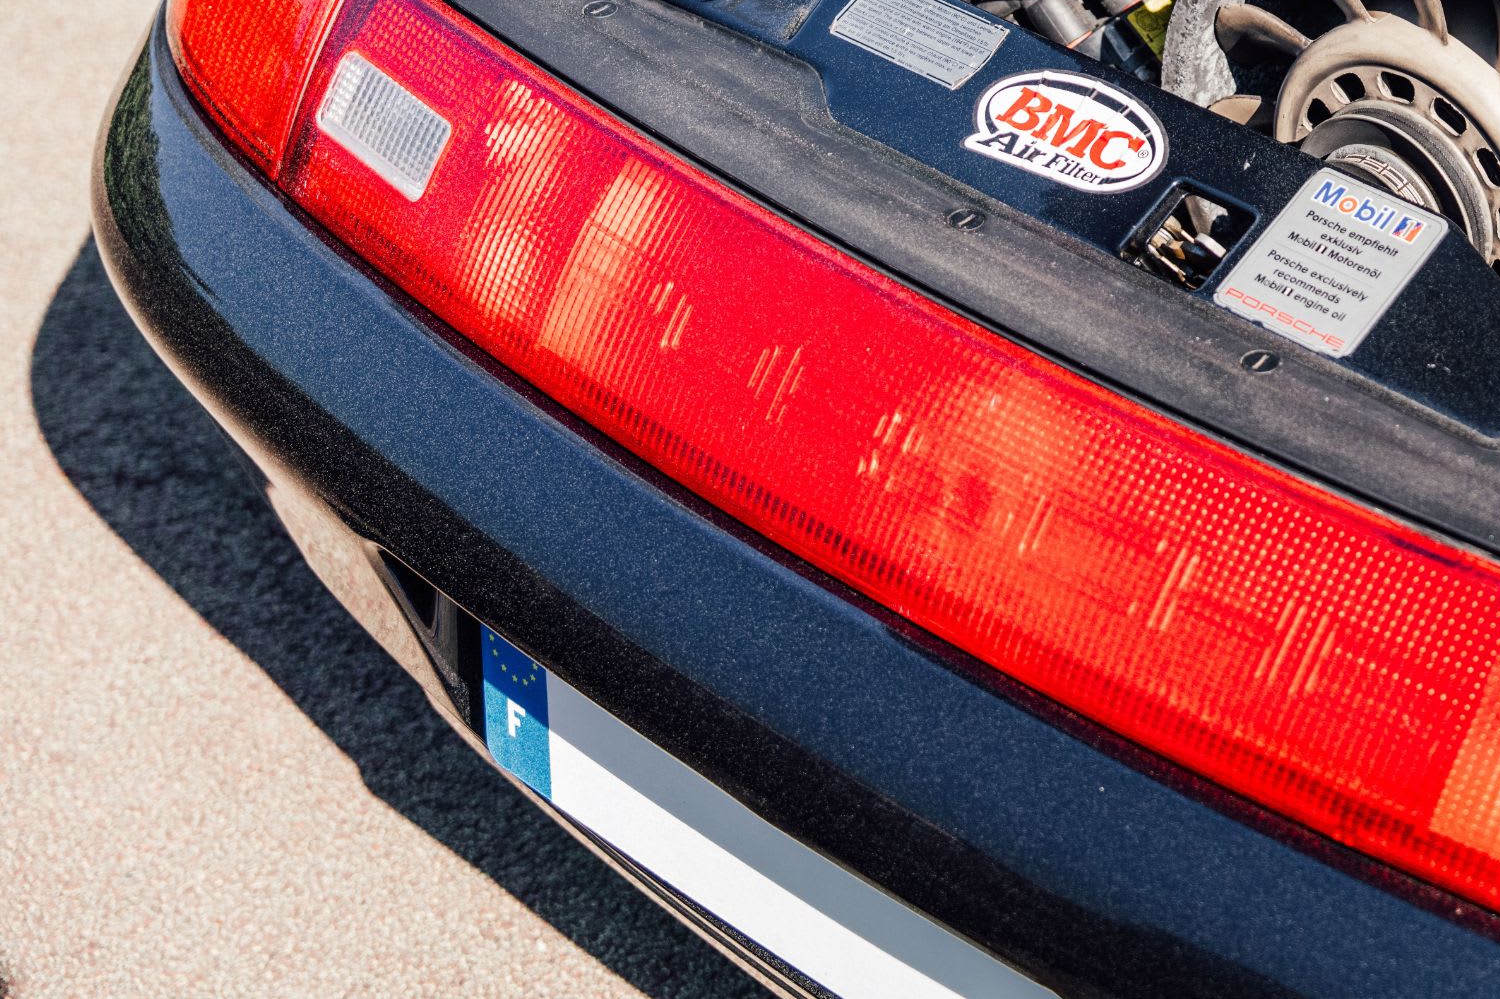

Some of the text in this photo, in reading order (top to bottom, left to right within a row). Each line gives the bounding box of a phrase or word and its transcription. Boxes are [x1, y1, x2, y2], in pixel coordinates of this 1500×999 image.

[995, 86, 1145, 170] BMC
[976, 131, 1104, 185] Air Filter
[1314, 180, 1396, 229] Mobil
[1287, 230, 1317, 252] Mobil
[1328, 249, 1381, 280] Motorenöl
[1306, 209, 1399, 258] Porsche empfiehlt
[1320, 231, 1364, 256] exklusiv
[1254, 273, 1284, 294] Mobil
[1294, 292, 1330, 315] engine
[1331, 308, 1347, 322] oil
[1267, 249, 1369, 302] Porsche exclusively
[1273, 268, 1341, 304] recommends
[1225, 286, 1345, 350] PORSCHE
[507, 697, 526, 738] F
